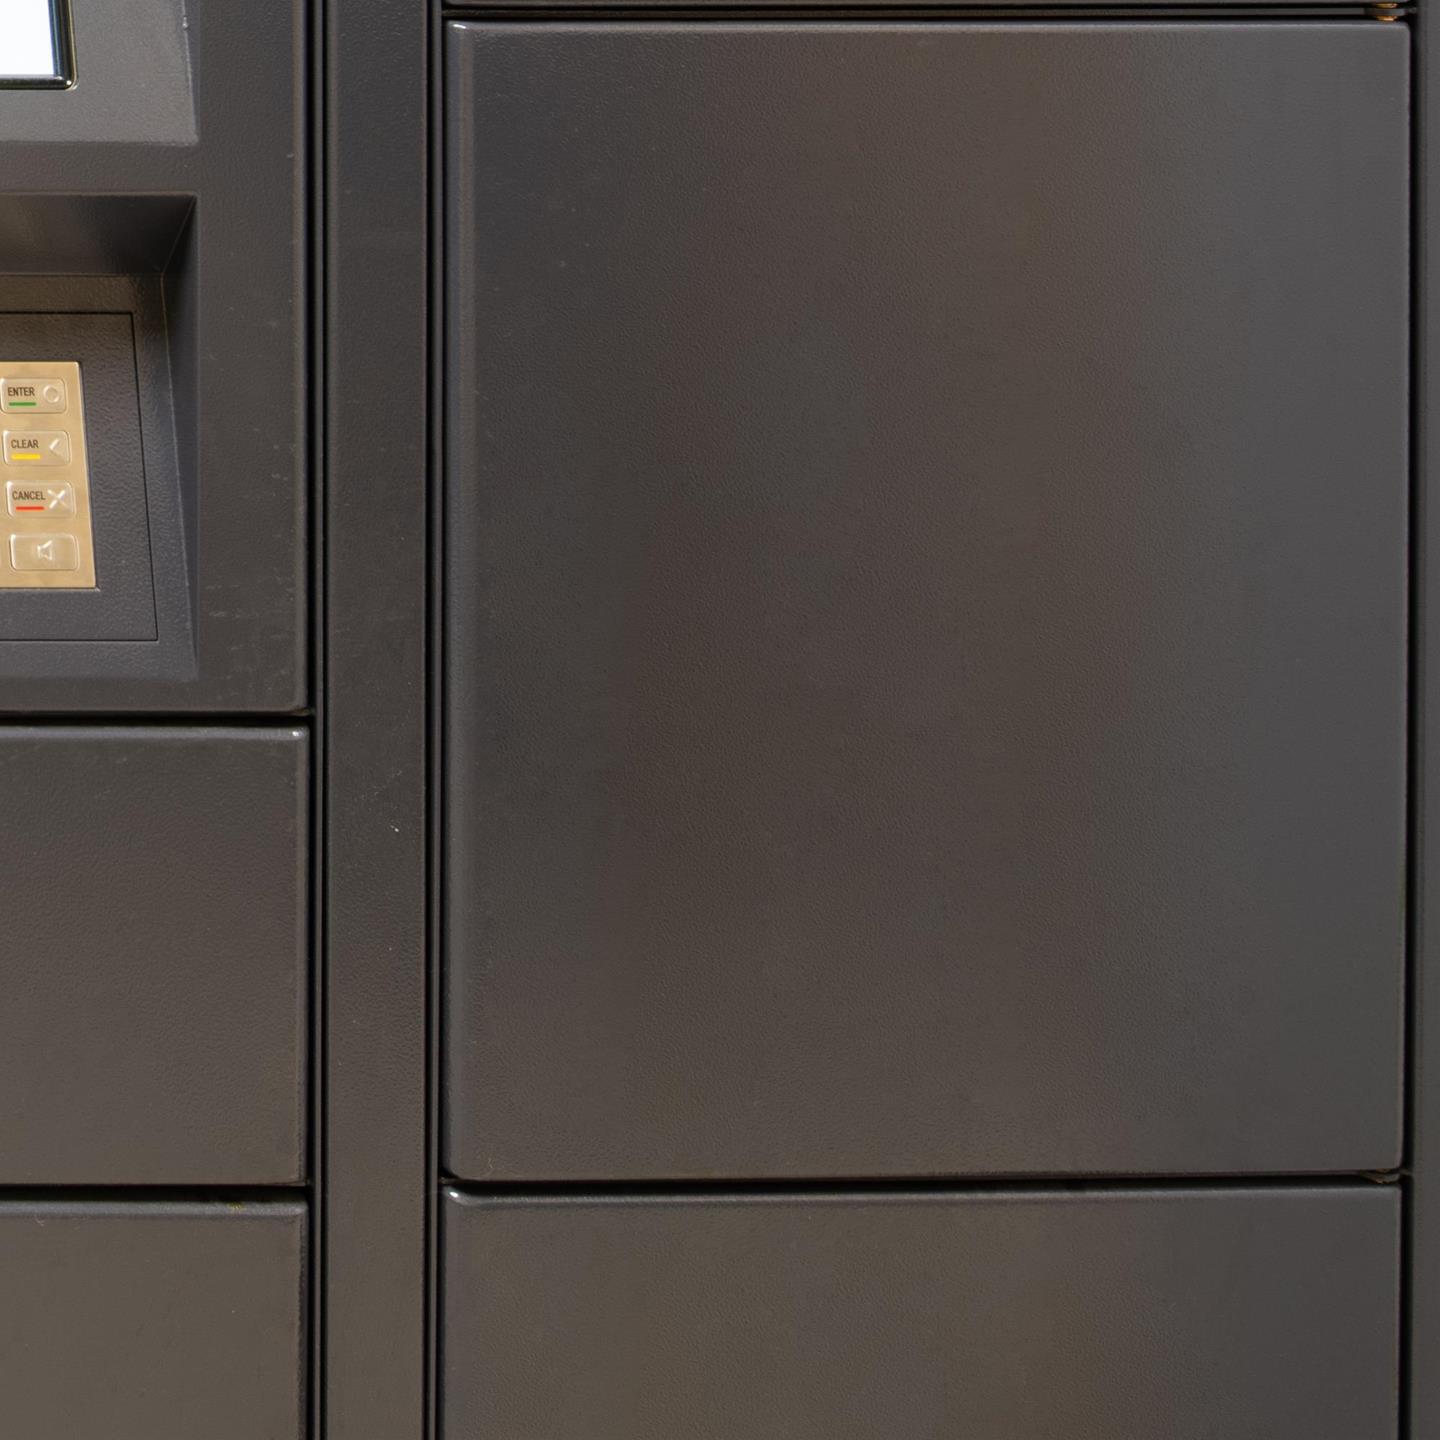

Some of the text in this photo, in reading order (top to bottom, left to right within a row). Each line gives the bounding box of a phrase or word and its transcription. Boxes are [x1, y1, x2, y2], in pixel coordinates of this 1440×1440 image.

[8, 387, 35, 396] ENTER
[11, 440, 39, 448] CLEAR
[12, 491, 46, 500] CANCEL
